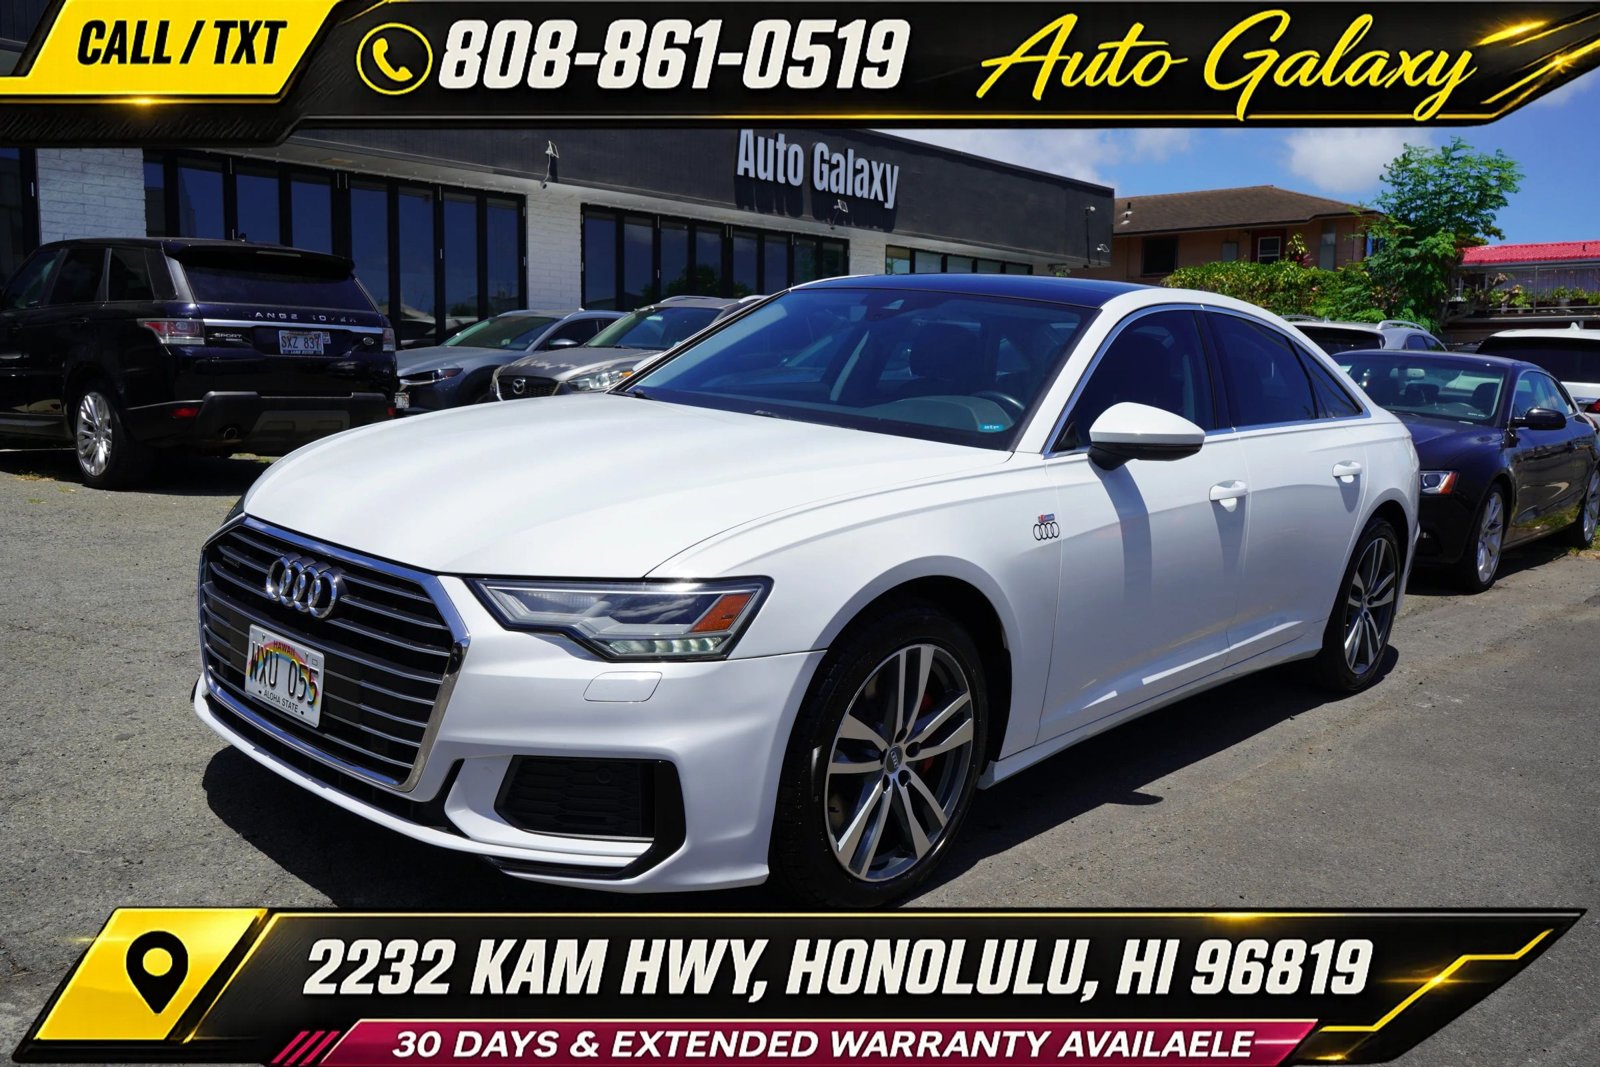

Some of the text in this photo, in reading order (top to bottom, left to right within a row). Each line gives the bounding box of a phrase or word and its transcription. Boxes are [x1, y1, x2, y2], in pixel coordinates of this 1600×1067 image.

[737, 129, 899, 209] Auto Galaxy
[263, 689, 299, 713] ALOHA STATE
[288, 658, 319, 706] 055
